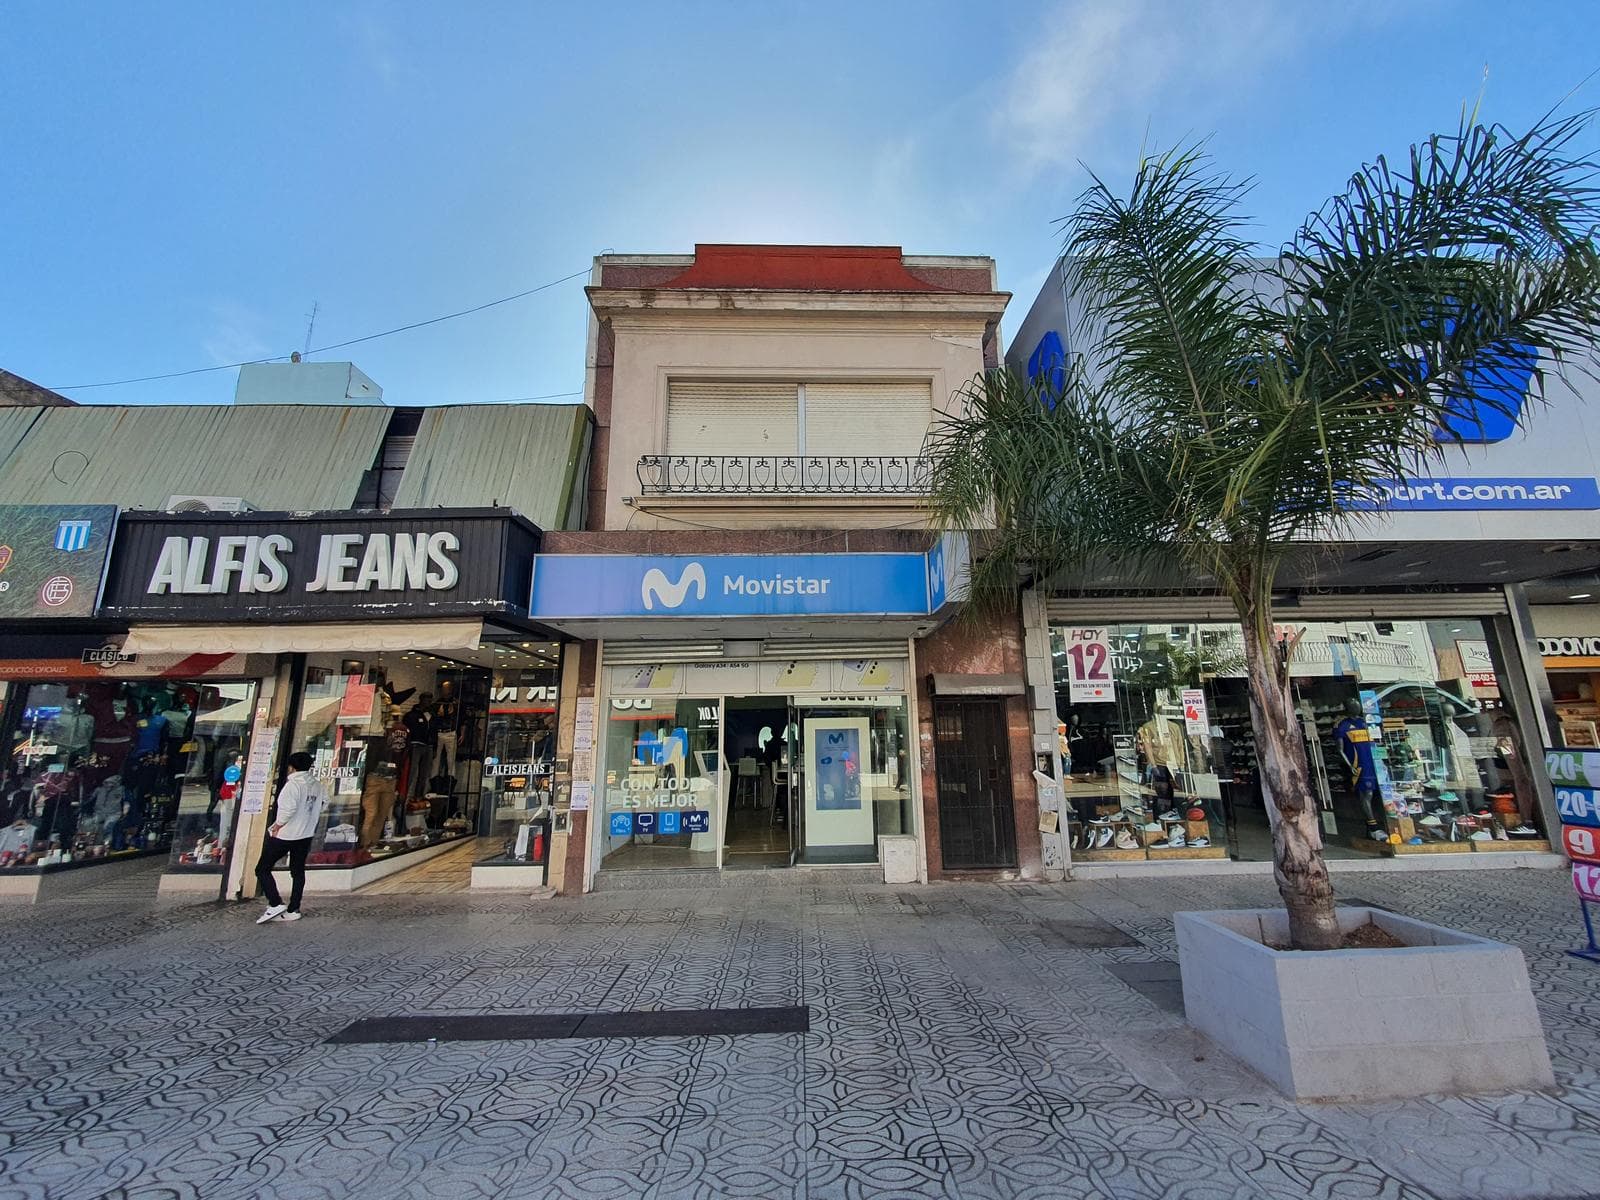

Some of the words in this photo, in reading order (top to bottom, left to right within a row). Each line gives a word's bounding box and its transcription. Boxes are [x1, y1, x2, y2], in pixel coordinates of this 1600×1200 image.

[1358, 481, 1571, 502] port.com.ar
[147, 534, 293, 595] ALFIS
[306, 531, 460, 592] JEANS
[723, 574, 831, 595] Movistar
[1071, 630, 1103, 640] HOY
[1068, 643, 1109, 680] 12
[1186, 705, 1199, 721] 4
[310, 767, 355, 778] FISJEANS
[492, 764, 545, 775] ALFISJEANS
[620, 778, 654, 791] CON
[658, 778, 692, 791] TOD
[622, 795, 641, 808] ES
[646, 794, 698, 808] MEJOR
[1568, 829, 1595, 855] 9
